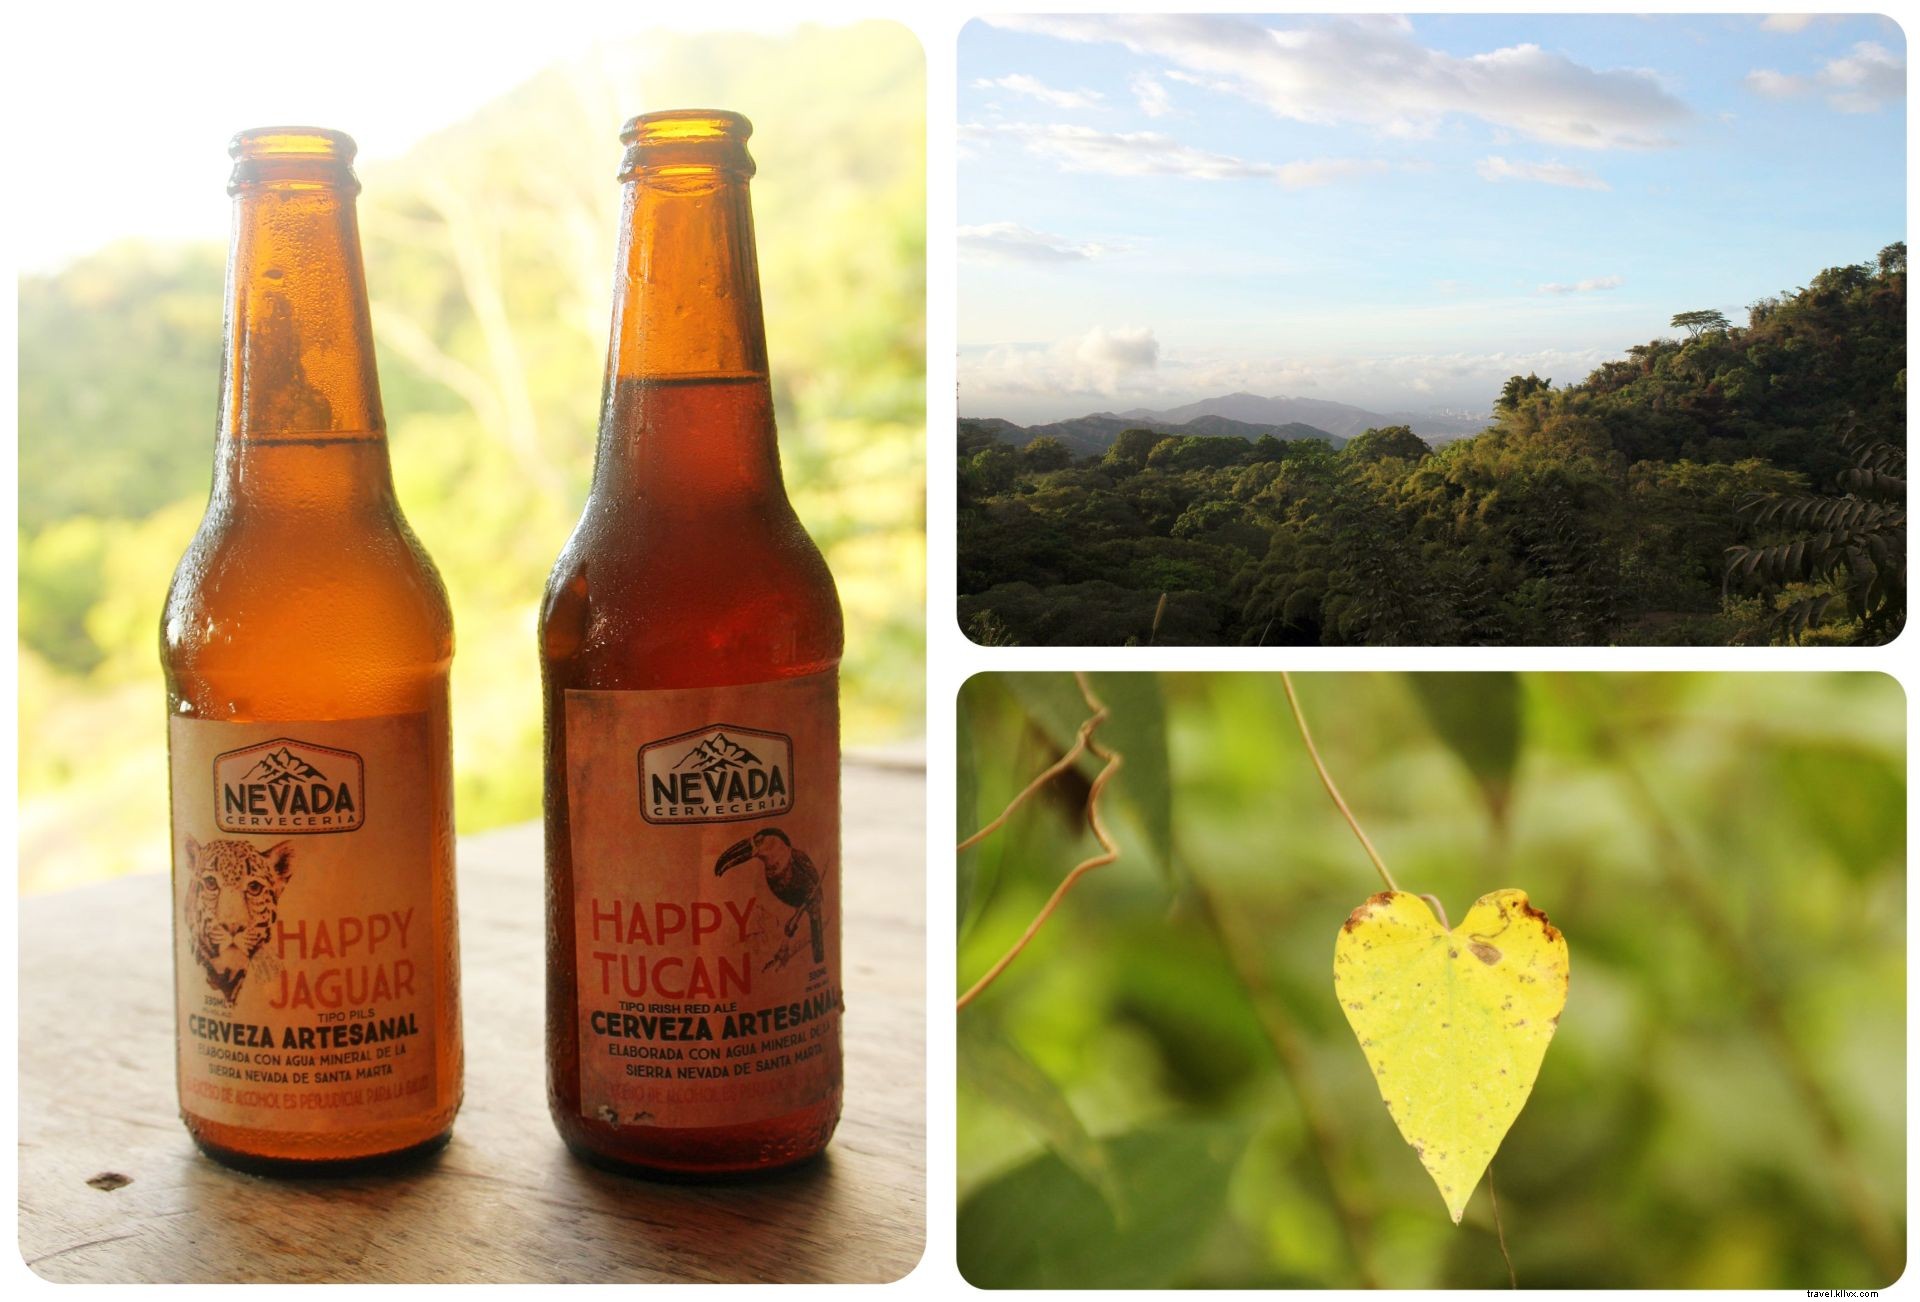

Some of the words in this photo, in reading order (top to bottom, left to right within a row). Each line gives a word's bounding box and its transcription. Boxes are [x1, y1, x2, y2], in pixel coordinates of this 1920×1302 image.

[224, 782, 355, 815] NEVADA
[652, 765, 786, 805] NEVADA
[226, 815, 355, 826] CERVECERIA
[654, 797, 786, 816] CERVECERIA
[277, 907, 415, 959] HAPPY
[592, 897, 757, 946] HAPPY
[268, 960, 416, 1010] JAGUAR
[593, 952, 751, 1000] TUCAN
[317, 1012, 345, 1023] TIPO
[350, 1008, 375, 1020] PILS
[591, 1009, 713, 1041] CERVEZA
[722, 986, 838, 1040] ARTESANAL
[619, 1001, 644, 1012] TIPO
[649, 1003, 680, 1014] IRISH
[684, 1004, 710, 1014] RED
[714, 1002, 737, 1013] ALE
[189, 1013, 275, 1049] CERVEZA
[282, 1013, 418, 1050] ARTESANAL
[609, 1043, 683, 1060] ELABORADA
[689, 1048, 720, 1060] CON
[726, 1043, 757, 1059] AGUA
[761, 1032, 807, 1053] MINERAL
[198, 1042, 250, 1063] ELABORADA
[254, 1053, 280, 1065] CON
[285, 1055, 315, 1067] AGUA
[320, 1050, 370, 1067] MINERAL
[376, 1046, 391, 1060] DE
[395, 1043, 406, 1056] LA
[626, 1064, 672, 1079] SIERRA
[677, 1066, 729, 1079] NEVADA
[734, 1063, 751, 1076] DE
[756, 1055, 791, 1073] SANTA
[208, 1064, 241, 1079] SIERRA
[245, 1070, 288, 1084] NEVADA
[293, 1072, 309, 1084] DE
[315, 1070, 351, 1083] SANTA
[356, 1064, 393, 1079] MARTA
